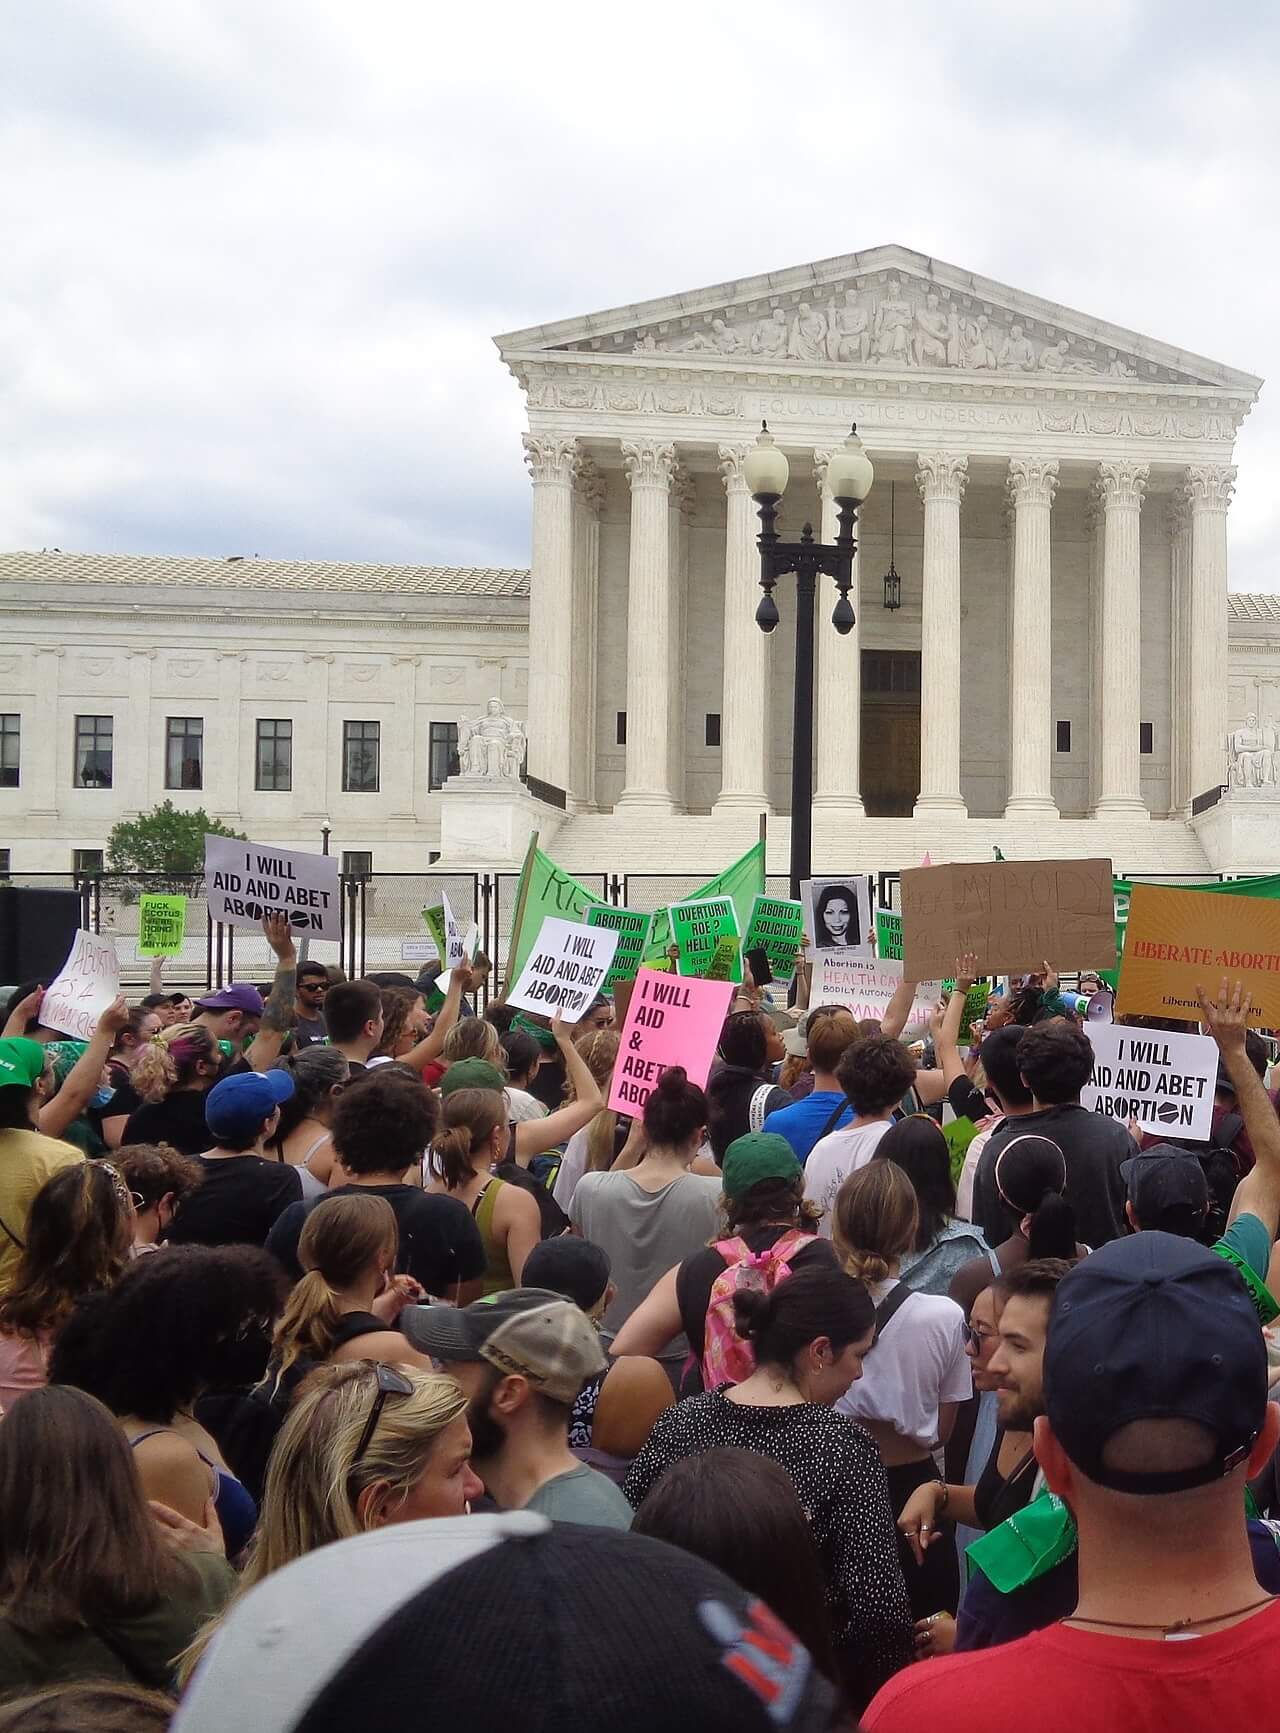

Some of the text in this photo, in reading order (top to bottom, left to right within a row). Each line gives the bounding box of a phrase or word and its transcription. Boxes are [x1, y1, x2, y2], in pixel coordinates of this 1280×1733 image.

[759, 399, 1023, 425] EQUAL JUSTICE UNDER LAW
[246, 853, 297, 880] I WILL
[213, 871, 331, 909] AID AND ABET
[595, 913, 643, 932] ABORTION
[678, 903, 728, 922] OVERTURN
[758, 902, 793, 919] ¡ABORTO
[754, 920, 798, 938] SOLICITUD
[563, 934, 596, 959] I WILL
[686, 938, 710, 953] HELL
[772, 940, 799, 956] PEDIR
[1133, 941, 1213, 966] LIBERATE
[530, 954, 604, 988] AID AND ABET
[823, 958, 864, 969] Abortion
[823, 971, 876, 986] HEALTH
[823, 985, 855, 996] BODILY
[523, 980, 590, 1012] ABORTION
[641, 980, 692, 1008] I WILL
[634, 1005, 665, 1029] AID
[629, 1031, 643, 1051] &
[1118, 1039, 1171, 1066] I WILL
[622, 1056, 667, 1083] ABET
[1088, 1064, 1207, 1099] AID AND ABET
[1095, 1095, 1194, 1126] ABORTION
